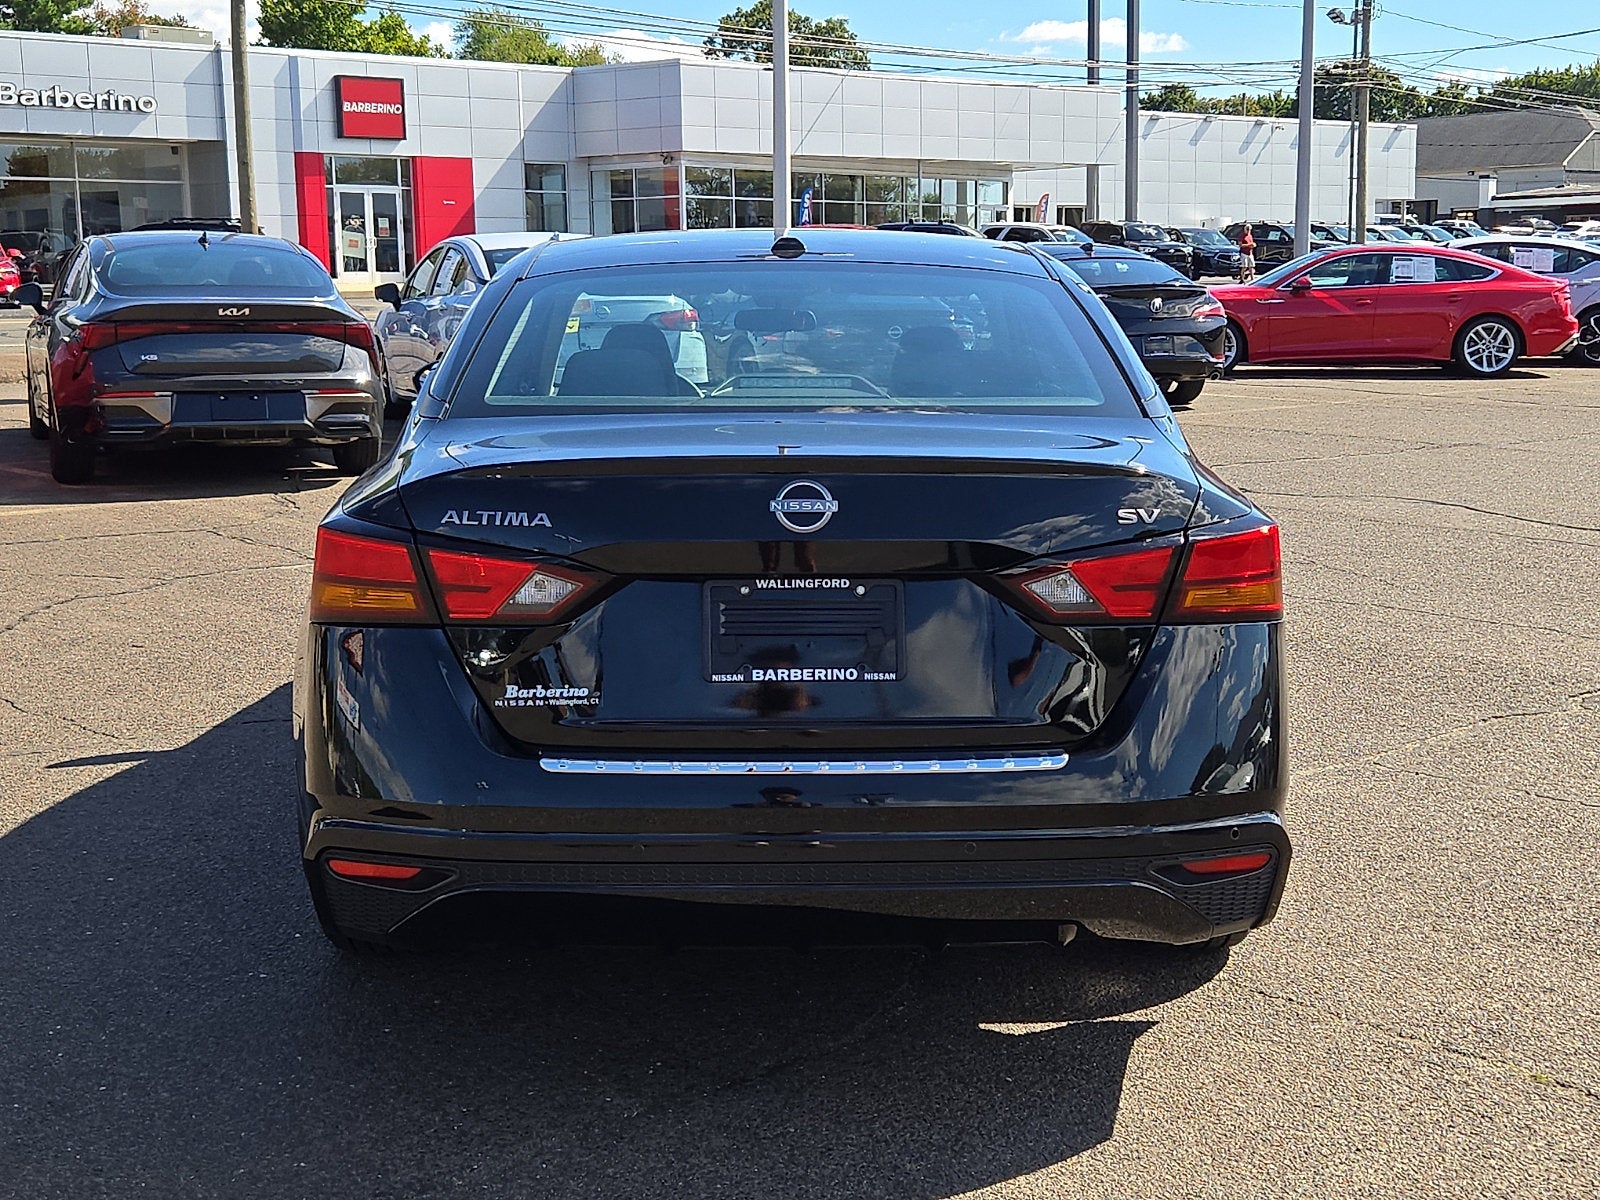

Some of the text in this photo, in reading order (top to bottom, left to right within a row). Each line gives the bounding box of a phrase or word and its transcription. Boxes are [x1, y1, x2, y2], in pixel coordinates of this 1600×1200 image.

[0, 82, 158, 113] Barberino
[343, 101, 403, 114] BARBERINO
[771, 501, 836, 510] NISSAN
[440, 510, 553, 528] ALTIMA
[1117, 508, 1161, 524] SV
[755, 579, 850, 589] WALLINGFORD
[711, 668, 897, 682] NISSAN BARBERINO NISSAN
[504, 684, 589, 698] Barberino
